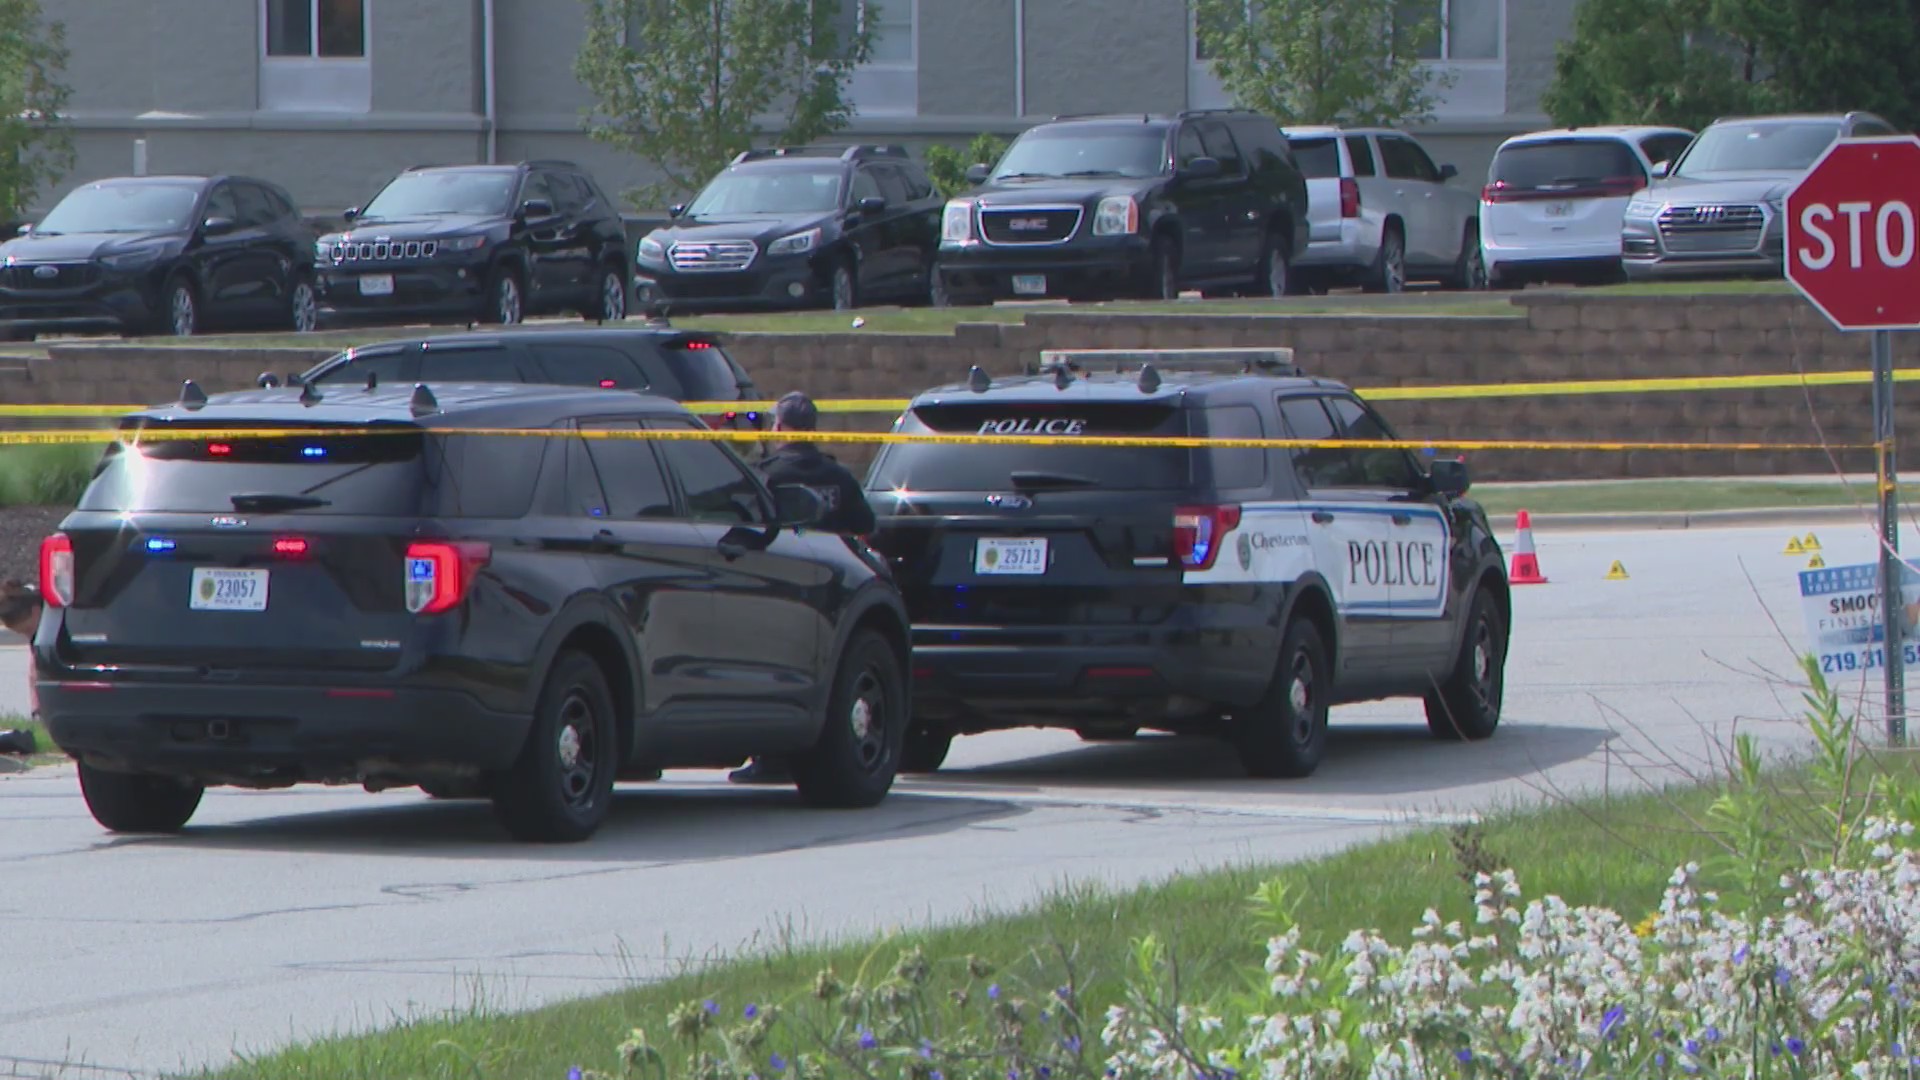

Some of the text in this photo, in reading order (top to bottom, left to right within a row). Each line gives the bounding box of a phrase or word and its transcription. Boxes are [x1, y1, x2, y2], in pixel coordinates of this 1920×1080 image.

[1009, 219, 1048, 230] GMC
[1799, 200, 1915, 270] STO
[976, 419, 1086, 435] POLICE
[1004, 549, 1040, 564] 25713
[1347, 540, 1436, 586] POLICE
[1807, 567, 1874, 583] TRANSF
[217, 579, 256, 598] 23057
